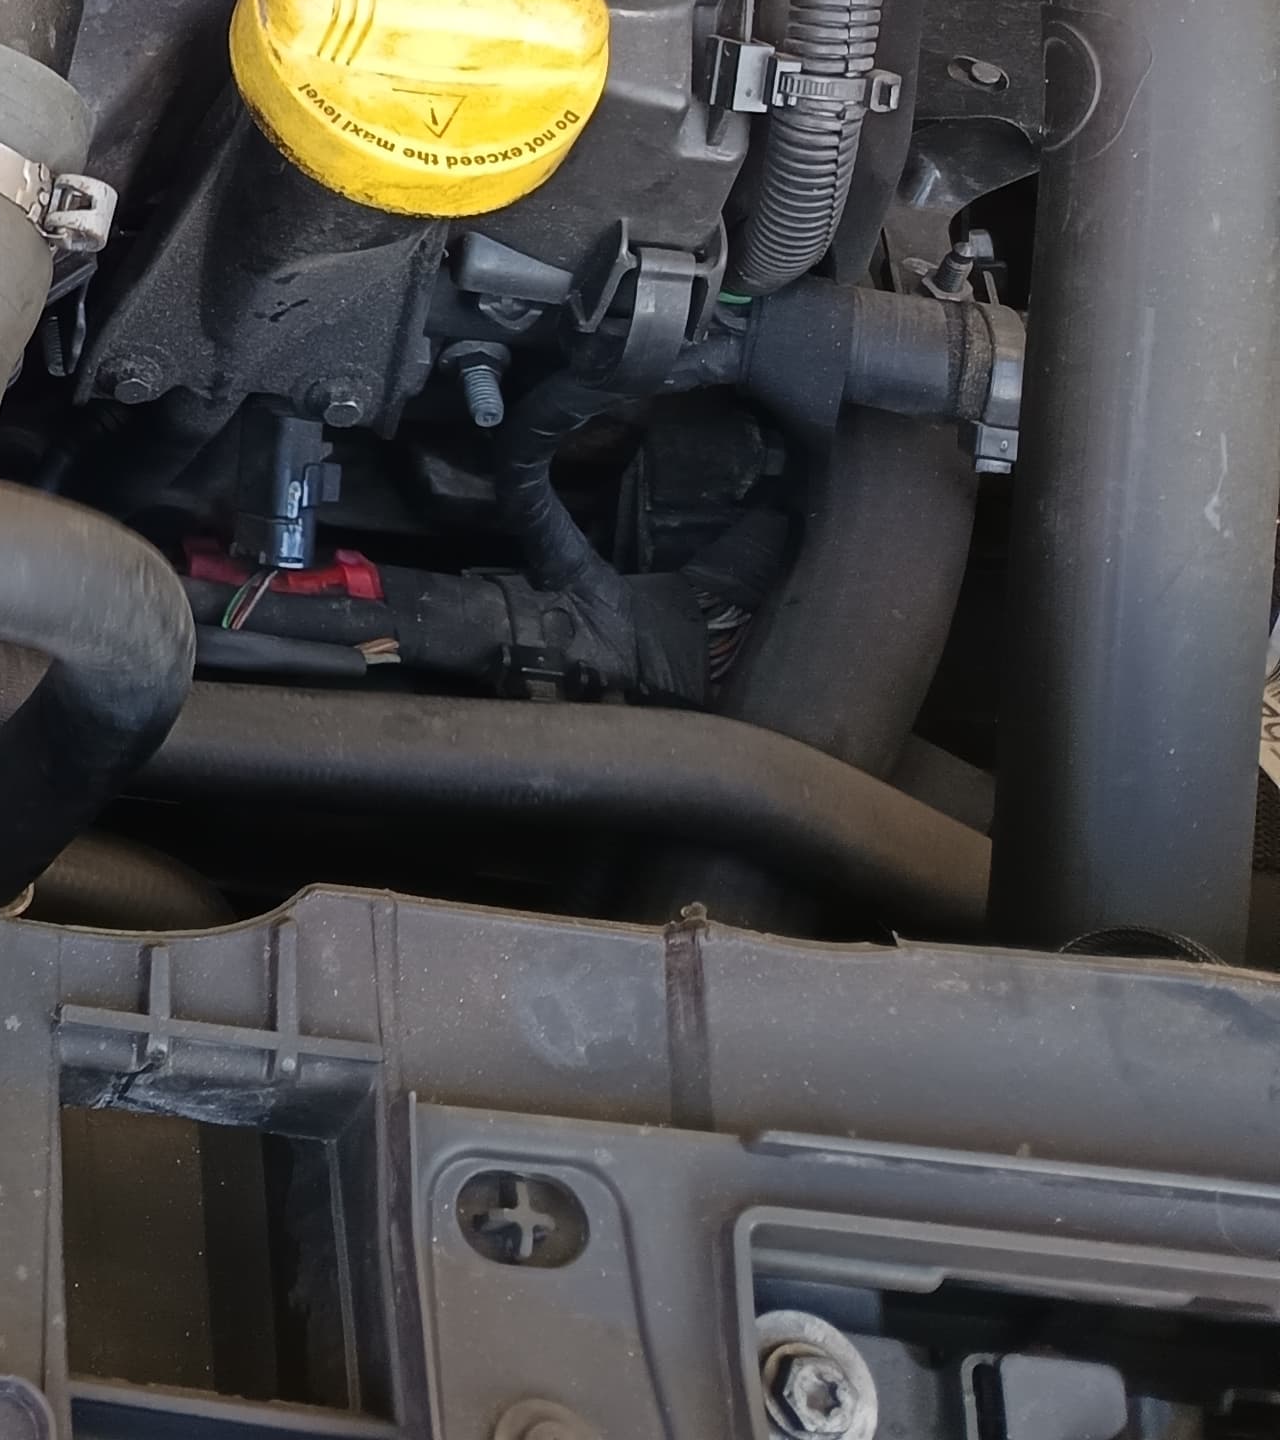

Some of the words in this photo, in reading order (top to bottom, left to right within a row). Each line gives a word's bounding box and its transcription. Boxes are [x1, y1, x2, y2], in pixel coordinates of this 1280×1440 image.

[297, 82, 342, 125] level
[555, 109, 581, 131] Do
[340, 120, 397, 153] maxi
[524, 128, 557, 155] not
[401, 147, 440, 166] the
[445, 145, 524, 170] exceed
